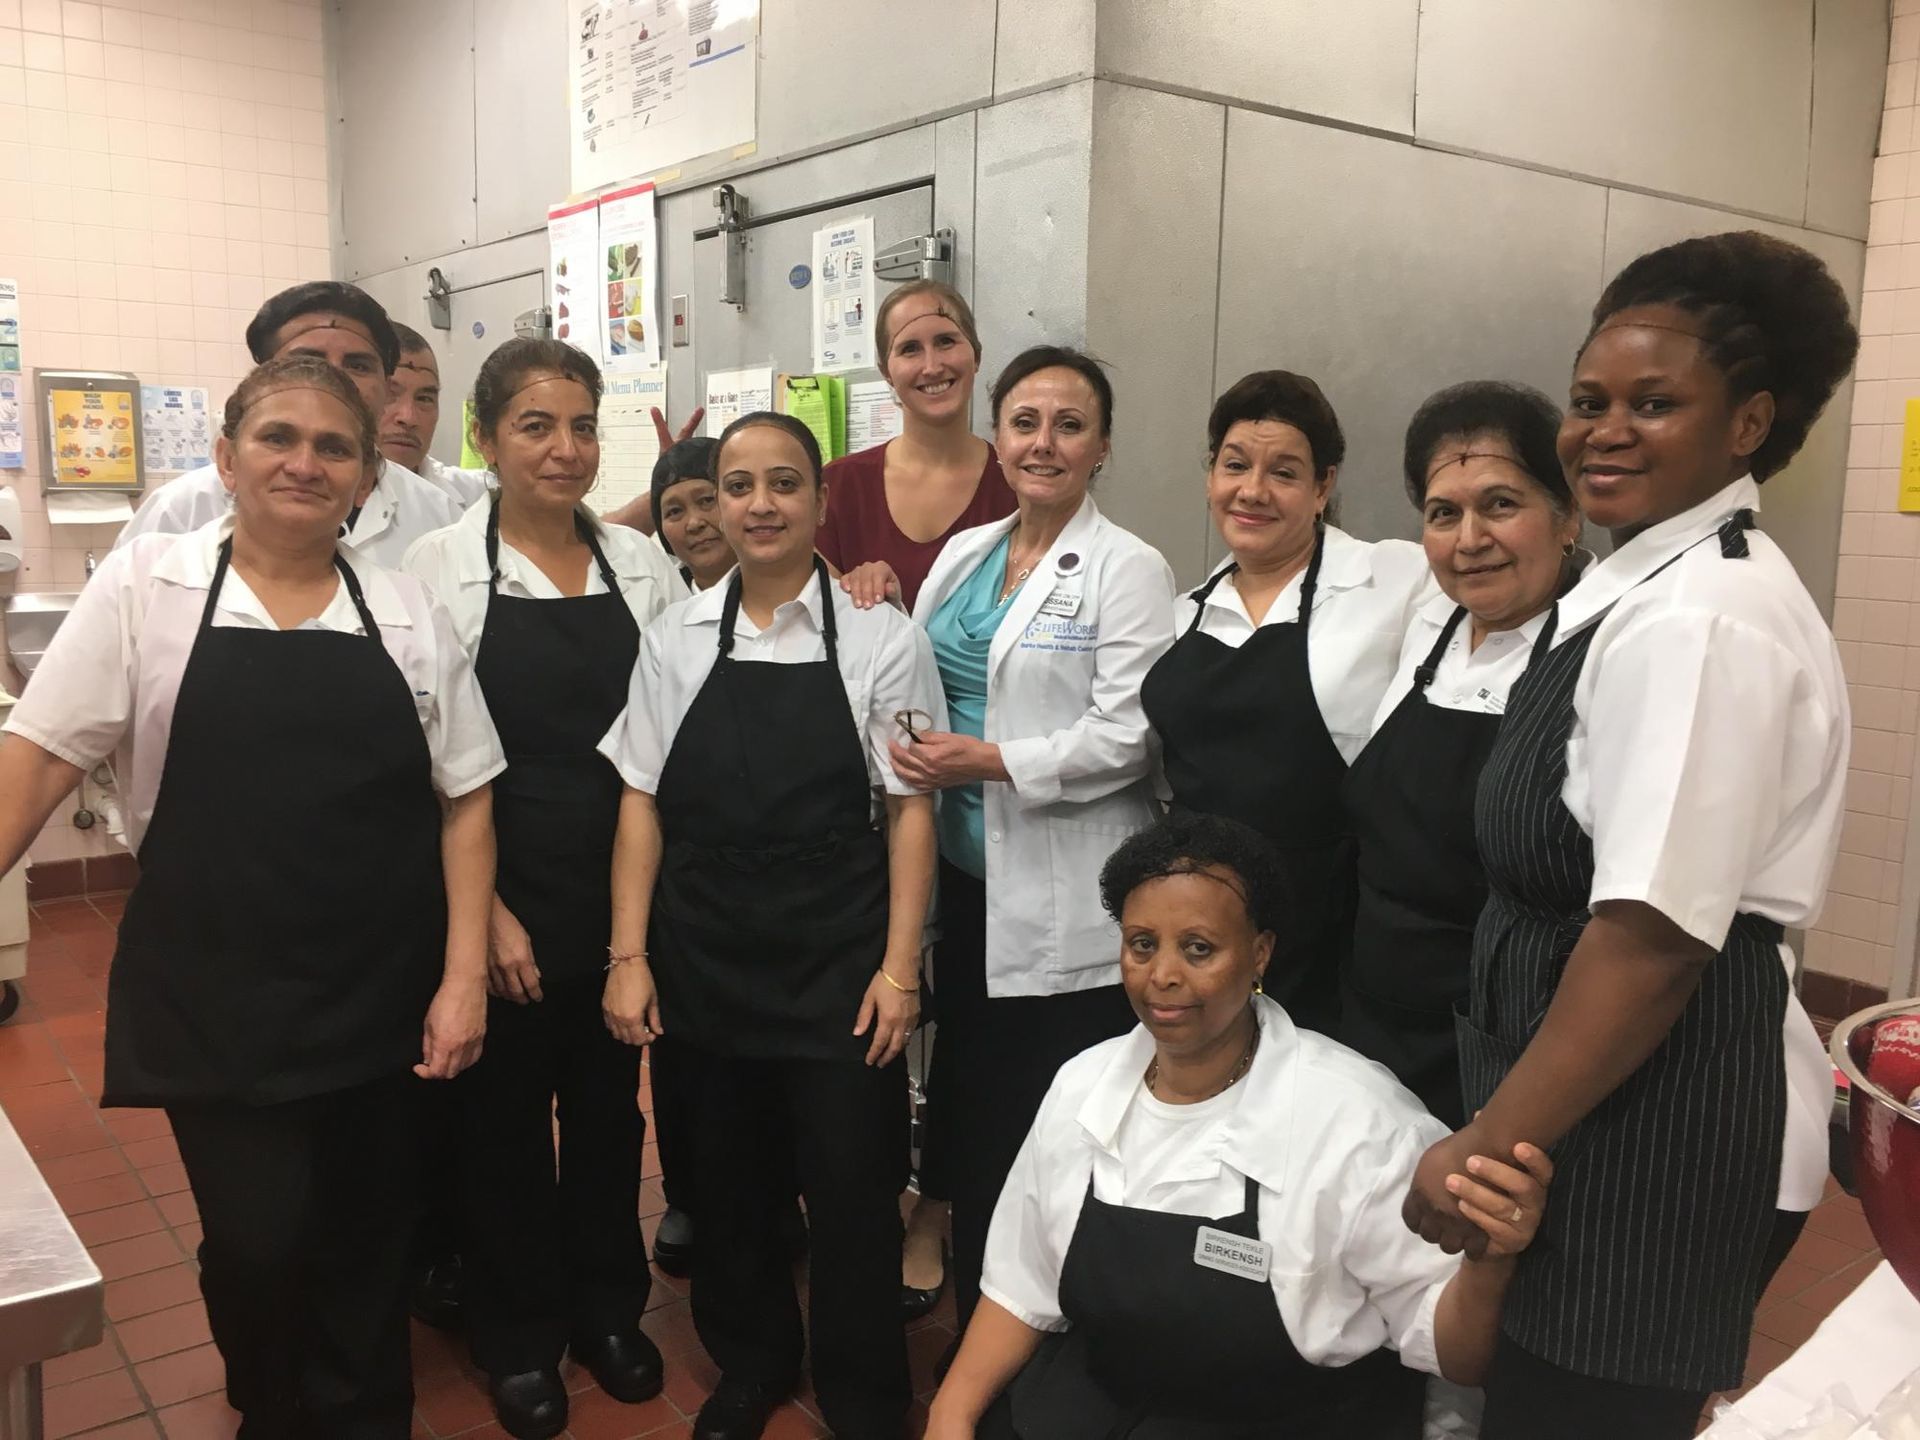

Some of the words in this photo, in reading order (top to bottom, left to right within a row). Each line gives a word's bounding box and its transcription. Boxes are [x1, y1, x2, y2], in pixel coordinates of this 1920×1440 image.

[611, 380, 631, 394] Menu
[633, 378, 664, 393] Planner
[1204, 1242, 1263, 1267] BIRKENSH
